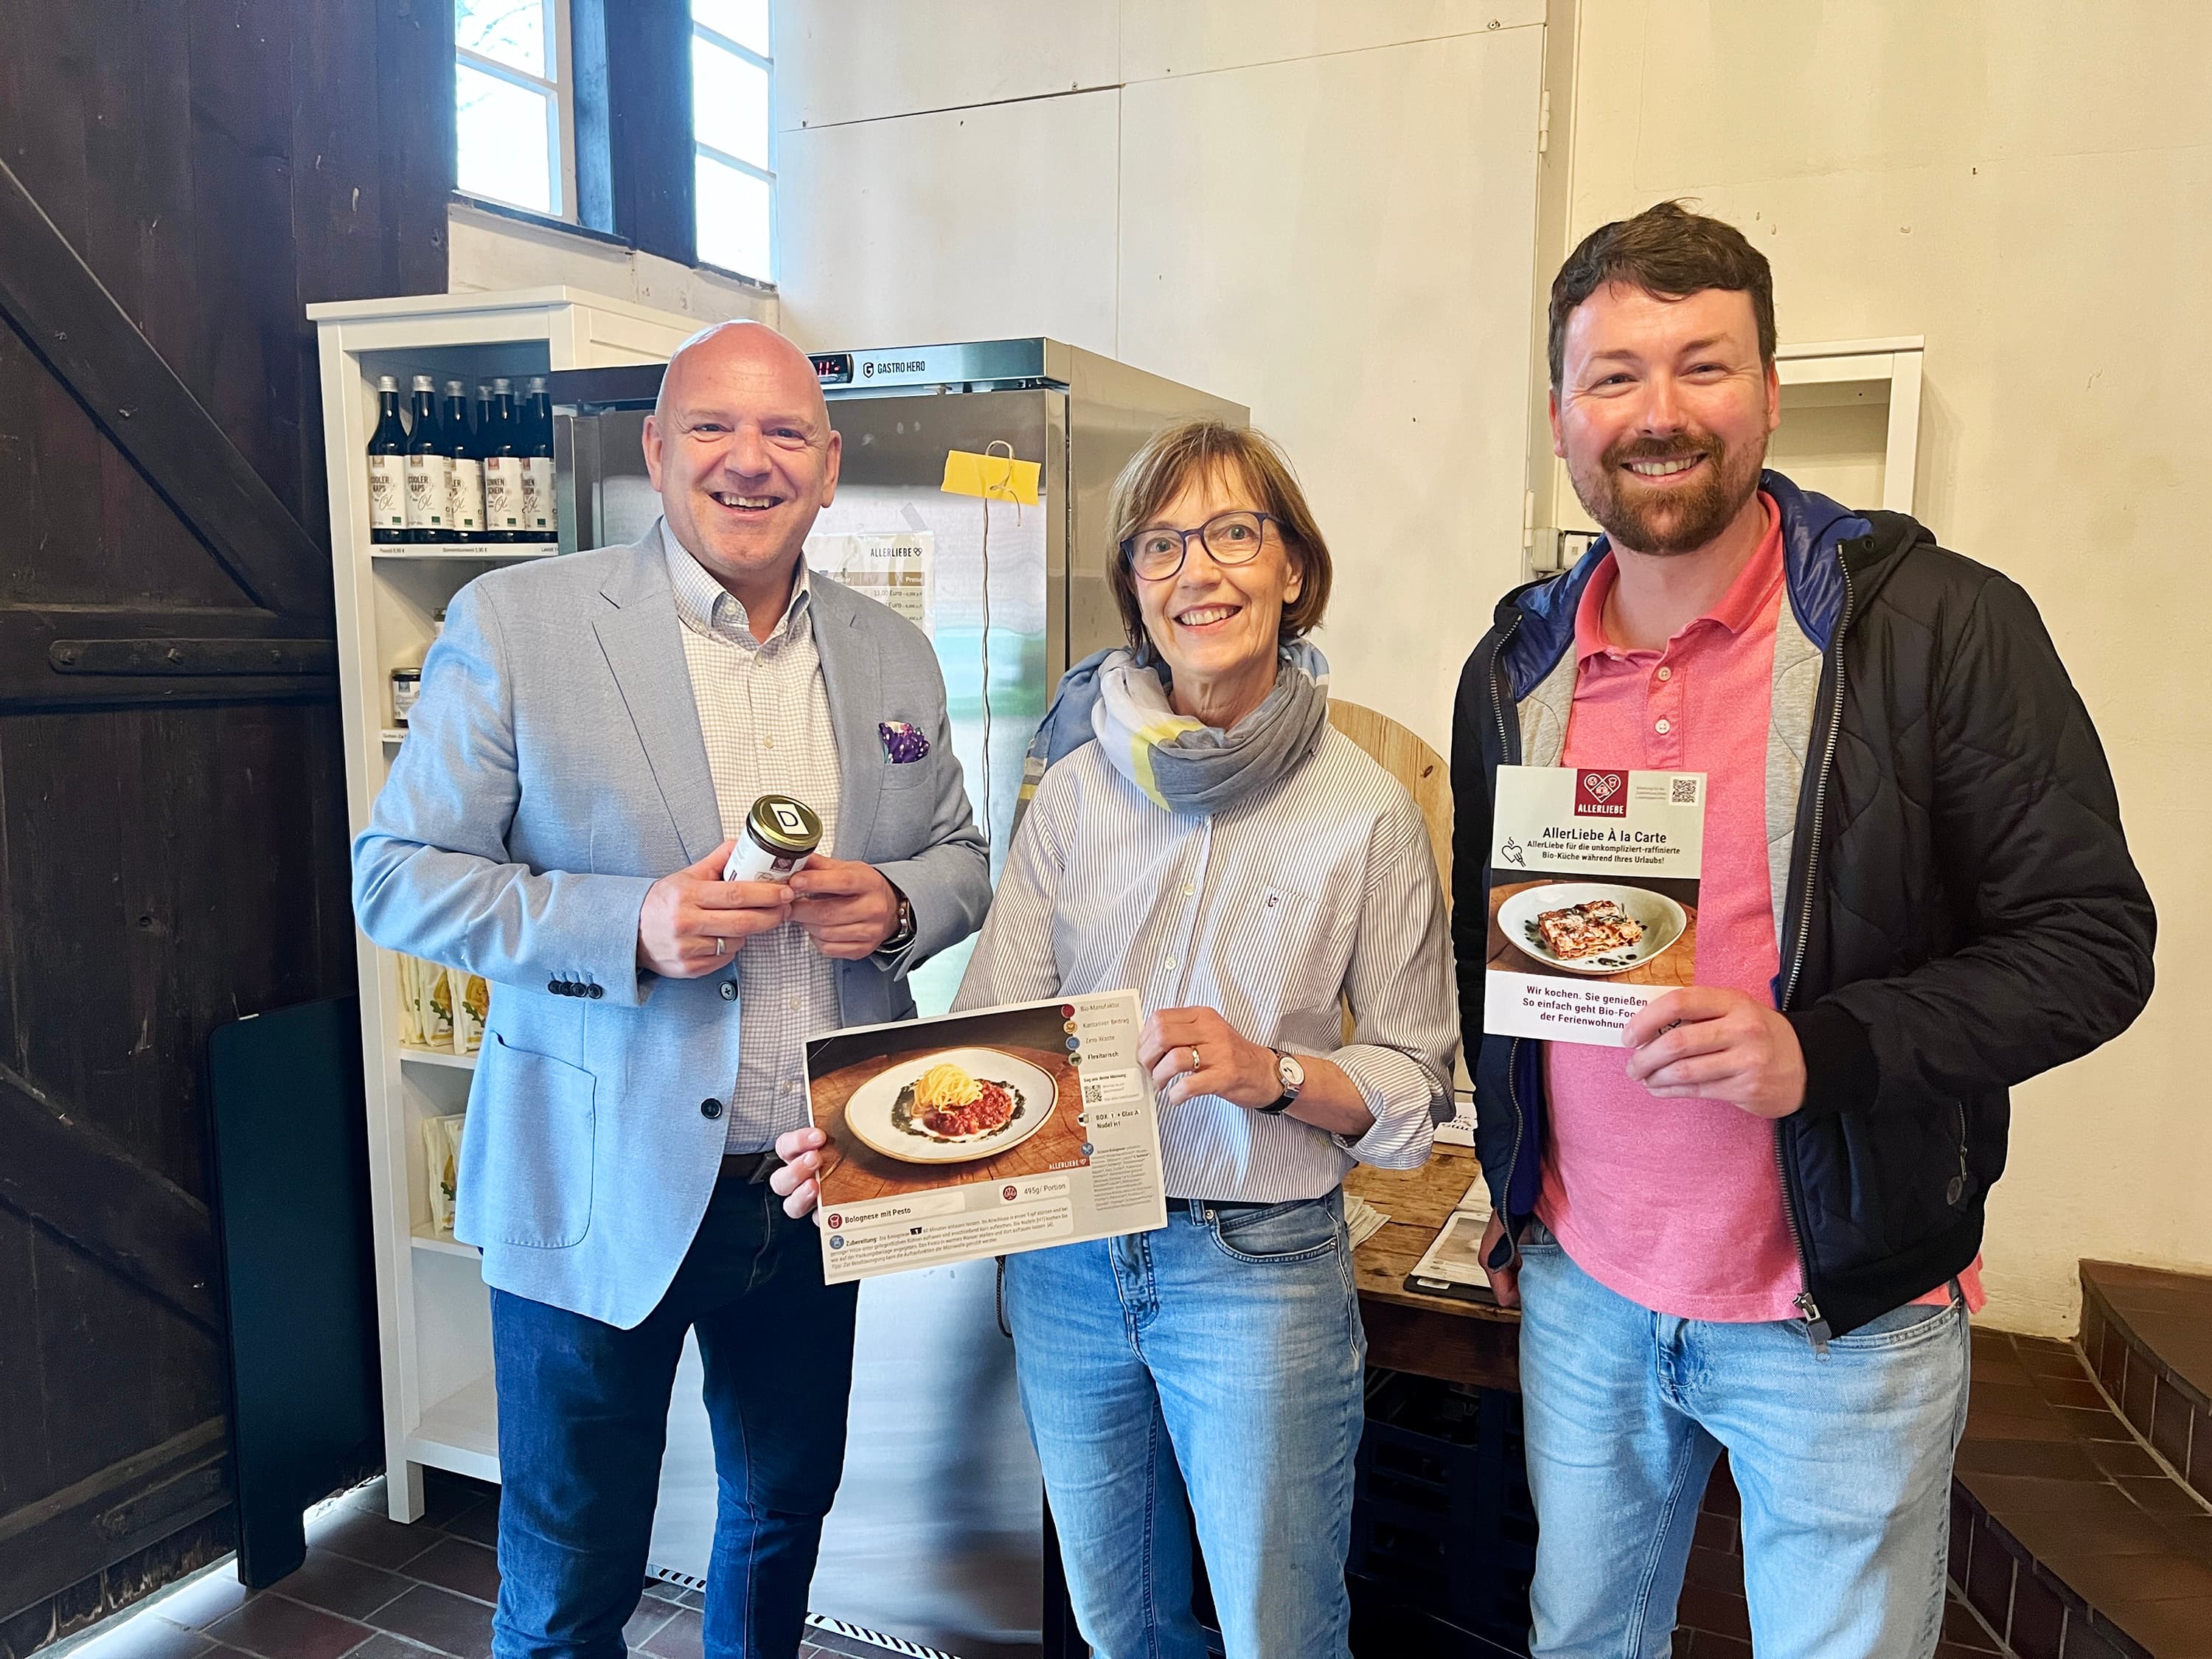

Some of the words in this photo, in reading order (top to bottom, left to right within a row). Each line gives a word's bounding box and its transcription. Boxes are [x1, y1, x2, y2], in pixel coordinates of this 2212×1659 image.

[877, 363, 905, 374] GASTRO
[906, 361, 925, 372] HERO
[871, 548, 911, 557] ALLERLIEBE
[1578, 804, 1624, 814] ALLERLIEBE
[777, 811, 799, 827] D
[1543, 827, 1604, 841] AllerLiebe
[1607, 827, 1616, 841] À
[1621, 830, 1631, 842] la
[1635, 831, 1666, 844] Carte
[1527, 840, 1565, 849] AllerLiebe
[1579, 843, 1590, 851] die
[1591, 844, 1680, 855] unkompliziert-raffinierte
[1542, 852, 1580, 860] Bio-Küche
[1582, 853, 1613, 862] während
[1614, 855, 1633, 863] Ihres
[1635, 855, 1665, 864] Urlaubs!
[1526, 985, 1542, 995] Wir
[1545, 987, 1582, 1000] kochen.
[1585, 992, 1600, 1002] Sie
[1603, 995, 1648, 1007] genießen
[1523, 998, 1534, 1007] So
[1537, 999, 1572, 1012] einfach
[1575, 1004, 1596, 1015] geht
[1599, 1007, 1636, 1018] Bio-Foo
[1540, 1012, 1555, 1021] der
[1558, 1014, 1626, 1029] Ferienwohnun
[1088, 1051, 1119, 1060] Flexitarisch
[1049, 1159, 1079, 1170] ALLERLIEBE
[1043, 1183, 1066, 1192] Portion
[845, 1213, 879, 1224] Bolognese
[880, 1210, 891, 1218] mit
[892, 1207, 911, 1216] Pesto
